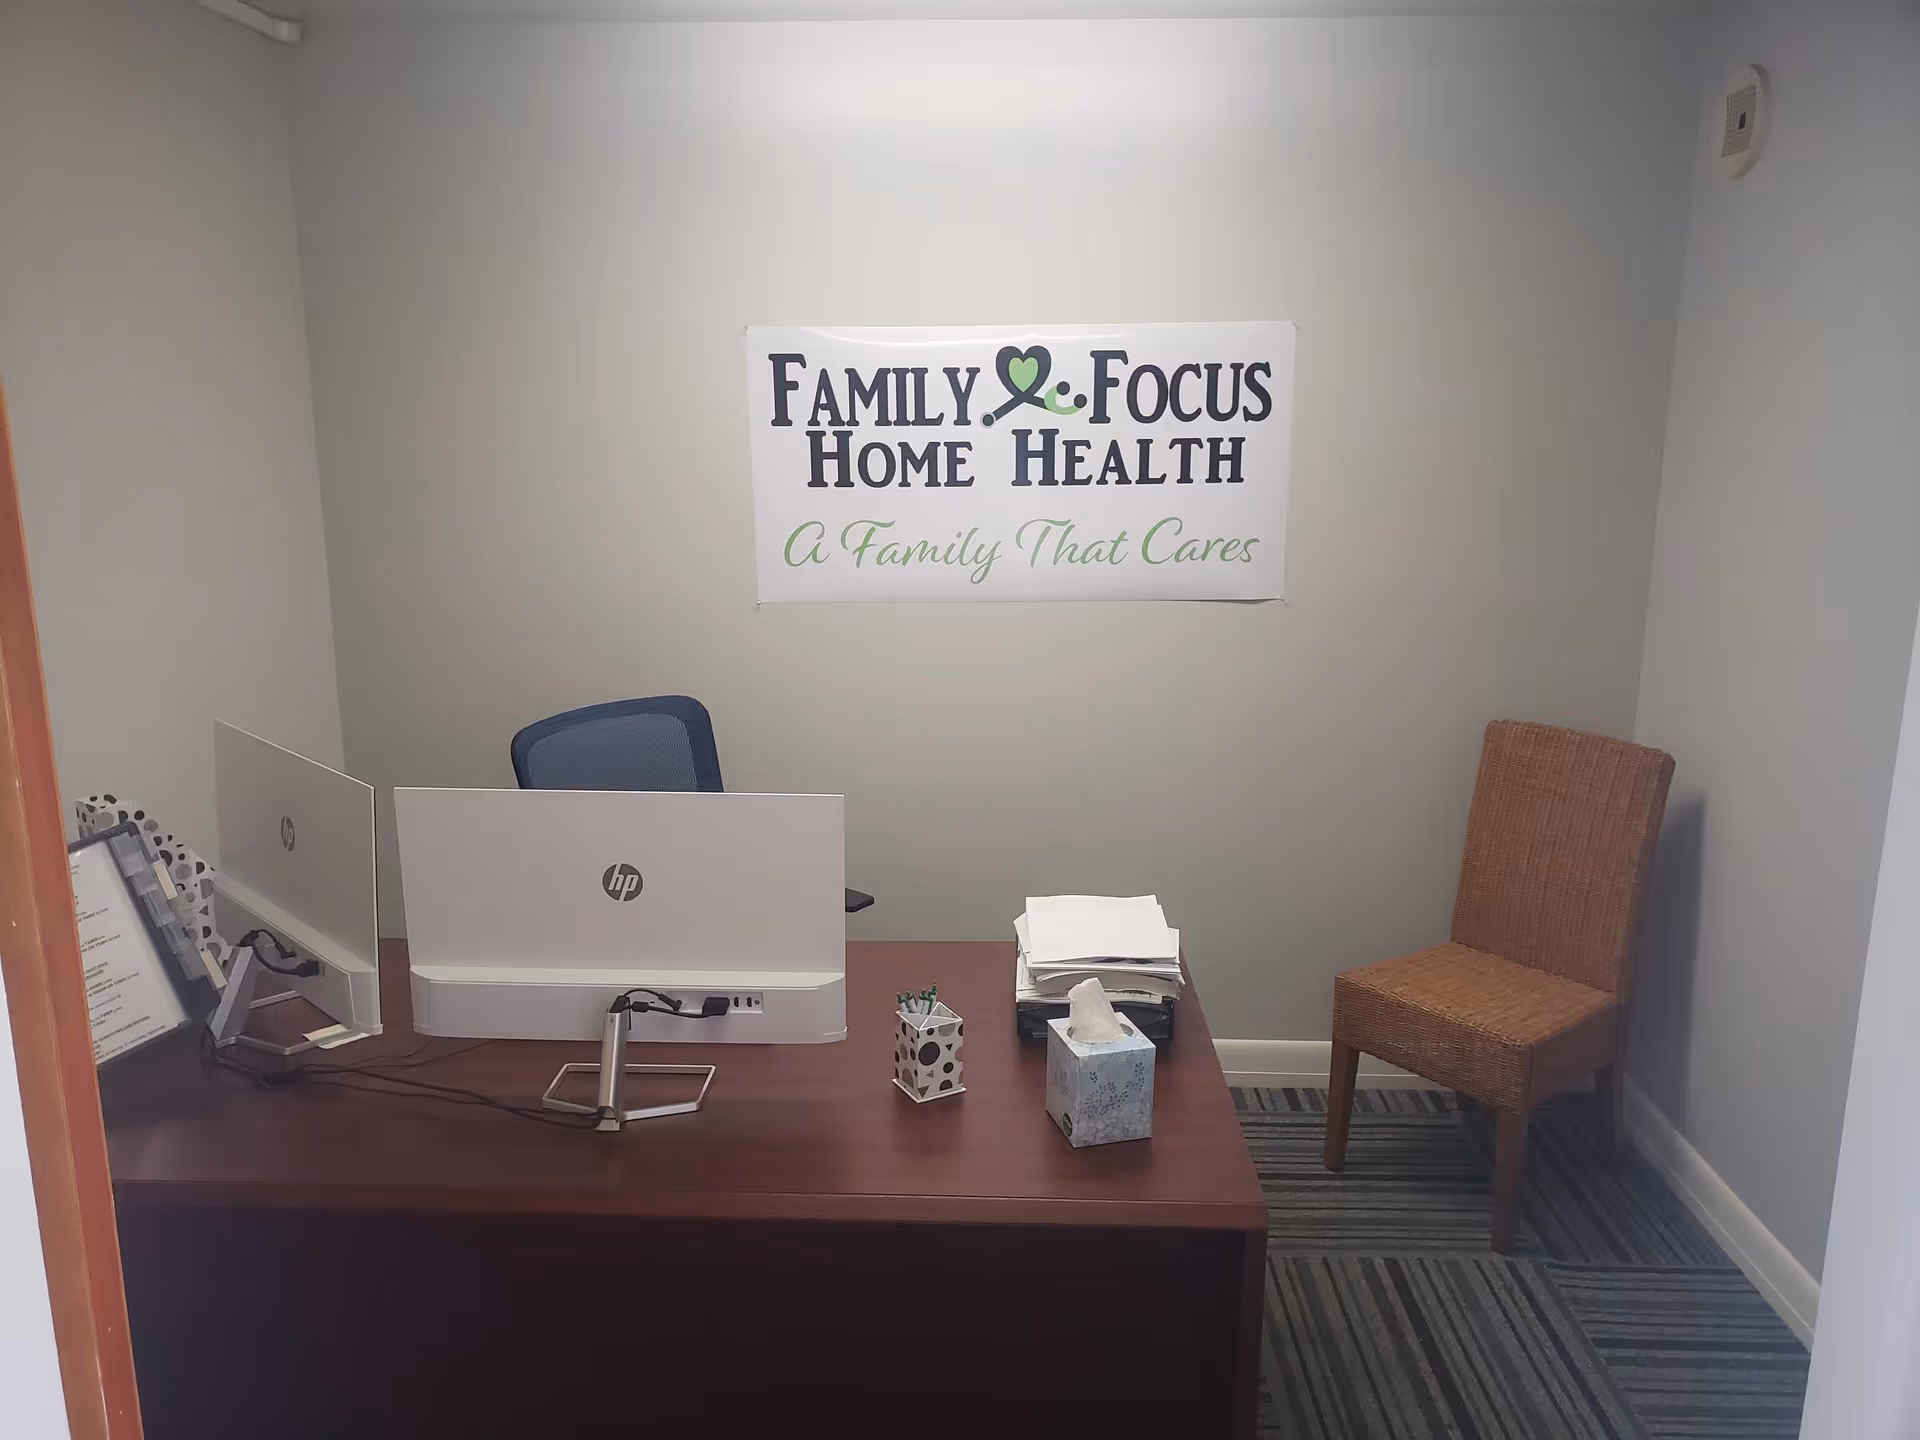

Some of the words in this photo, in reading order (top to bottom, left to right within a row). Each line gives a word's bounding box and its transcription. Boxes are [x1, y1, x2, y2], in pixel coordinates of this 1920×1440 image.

[768, 352, 980, 427] FAMILY
[1088, 349, 1272, 424] FOCUS
[805, 429, 975, 488] HOME
[1010, 428, 1246, 486] HEALTH
[784, 520, 830, 568] A
[840, 519, 1002, 584] Family
[1015, 518, 1129, 568] That
[1141, 516, 1260, 567] Cares
[281, 815, 296, 851] hp
[606, 862, 641, 901] hp
